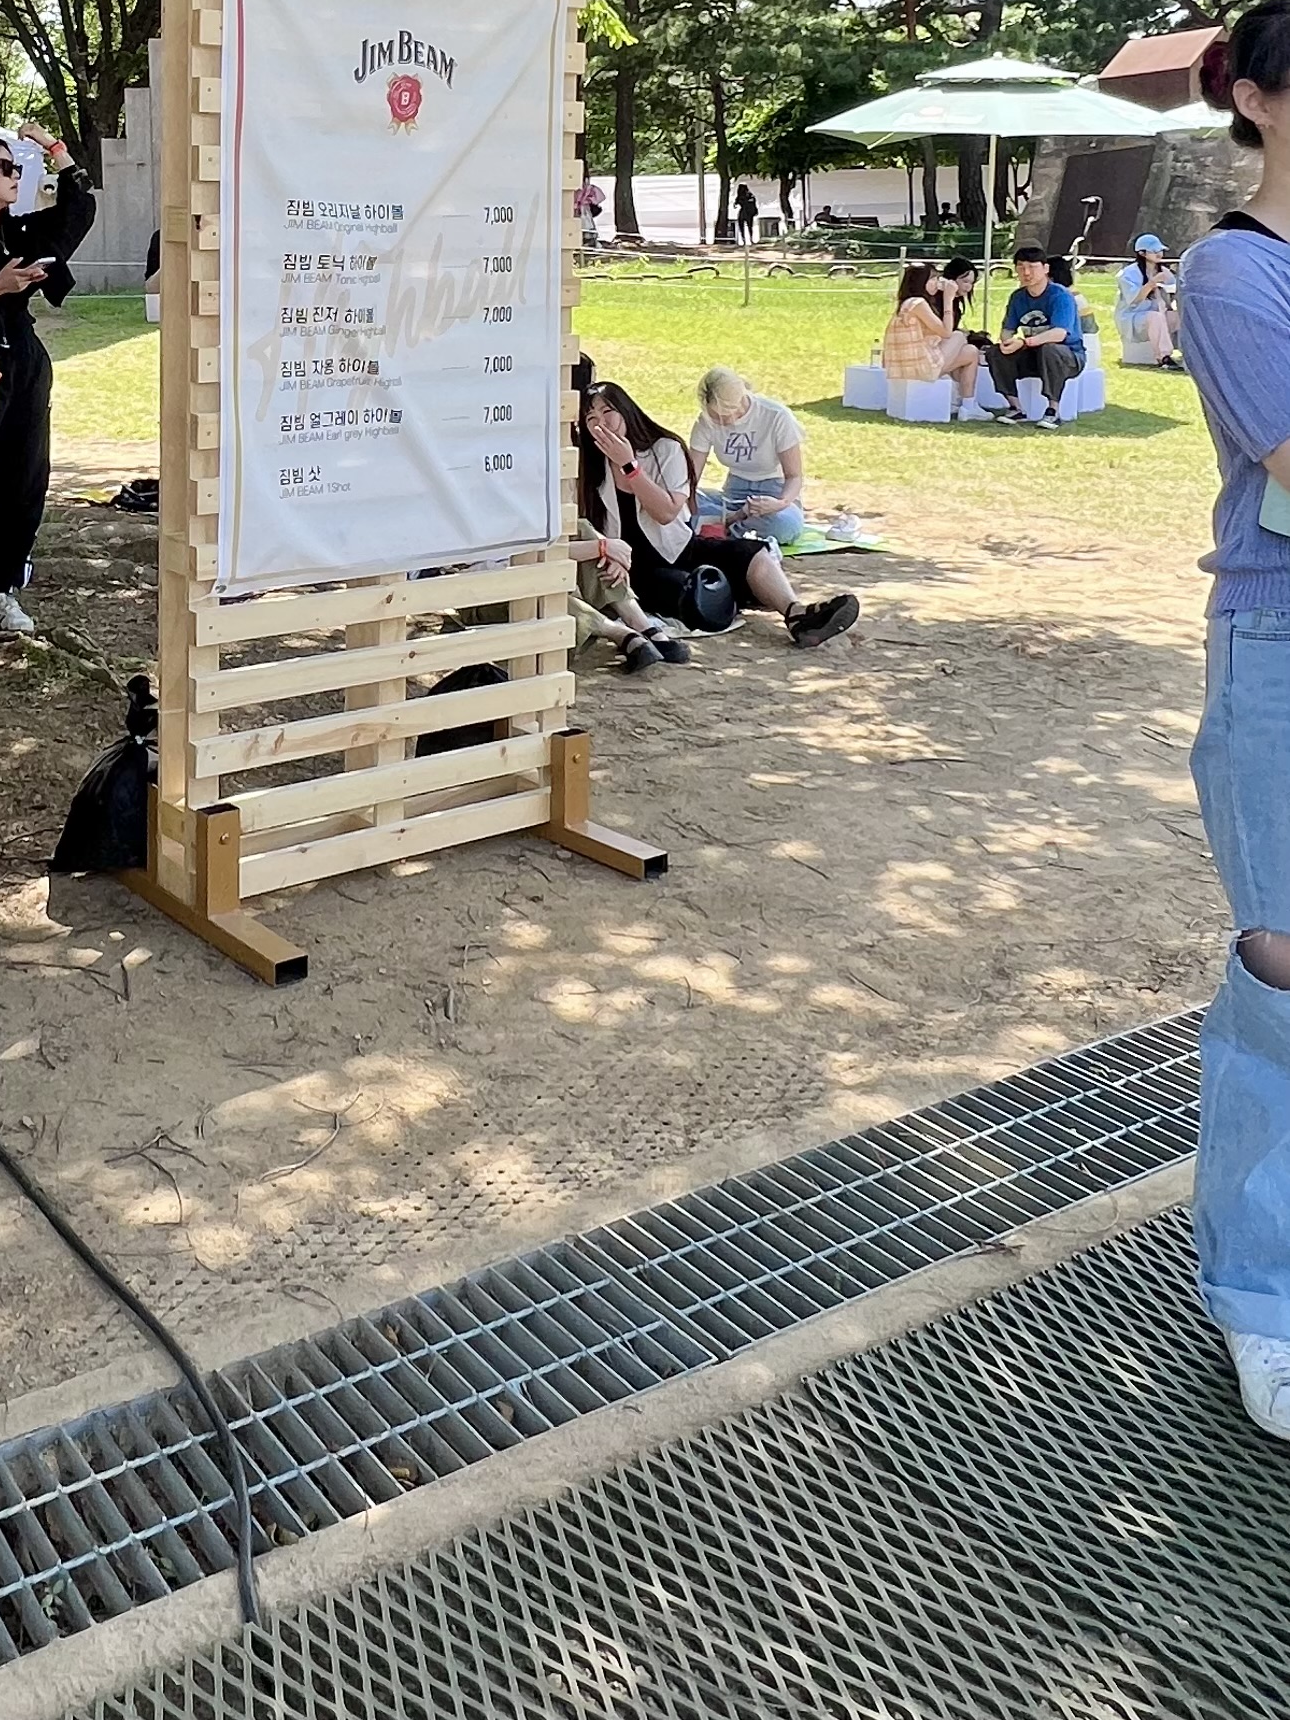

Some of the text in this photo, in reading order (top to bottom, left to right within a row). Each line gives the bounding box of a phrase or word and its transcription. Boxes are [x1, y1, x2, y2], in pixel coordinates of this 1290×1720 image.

[354, 30, 456, 90] JIM BEAM
[286, 199, 315, 217] 짐빔
[318, 202, 361, 219] 오리지날
[484, 206, 513, 226] 7,000
[283, 220, 304, 230] JIM
[306, 220, 332, 230] BEAM
[283, 253, 312, 271] 짐빔
[317, 254, 345, 271] 토닉
[483, 256, 512, 275] 7,000
[281, 273, 301, 284] JIM
[303, 273, 332, 284] BEAM
[280, 307, 309, 324] 짐빔
[312, 306, 339, 323] 진저
[483, 306, 512, 325] 7,000
[279, 327, 297, 338] JIM
[300, 326, 326, 337] BEAM
[280, 360, 307, 378] 짐빔
[483, 355, 513, 375] 7,000
[279, 380, 297, 392] JIM
[299, 379, 324, 391] BEAM
[280, 414, 306, 432] 짐빔
[309, 409, 359, 429] 얼그레이
[483, 404, 512, 425] 7,000
[279, 434, 296, 445] JIM
[298, 432, 324, 444] BEAM
[326, 429, 343, 441] Earl
[279, 453, 513, 486] 짐빔 샷 6,000
[279, 488, 296, 499] JIM
[297, 484, 324, 497] BEAM
